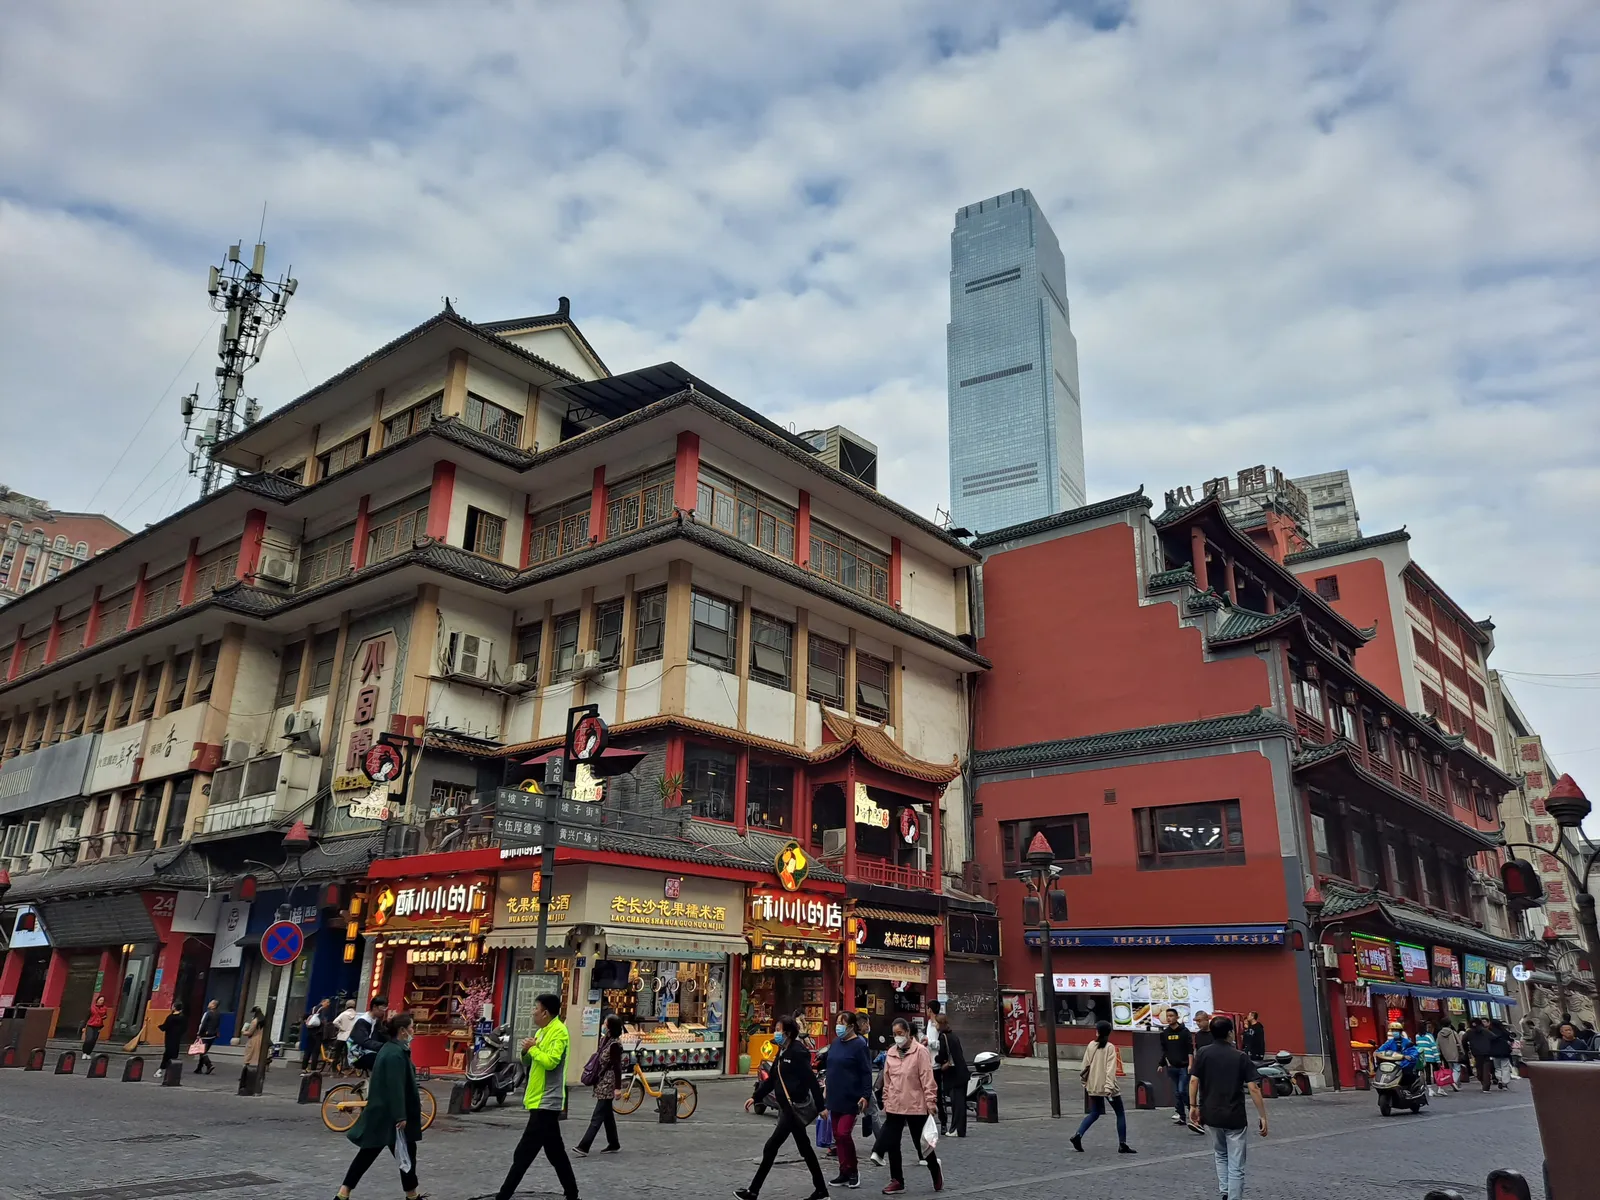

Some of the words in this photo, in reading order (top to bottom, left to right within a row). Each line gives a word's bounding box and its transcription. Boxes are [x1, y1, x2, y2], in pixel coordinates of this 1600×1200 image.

[345, 640, 386, 771] 火宫殿
[552, 757, 563, 783] 天心区
[507, 793, 544, 809] 坡子街
[561, 802, 594, 818] 坡子街
[504, 820, 542, 836] 伍厚德堂
[559, 828, 592, 844] 黄兴广场
[1520, 743, 1573, 931] 湖南省财政医院
[153, 896, 174, 911] 24
[611, 895, 726, 921] 老长沙花果糯米酒
[611, 914, 625, 923] LAO
[626, 915, 650, 924] CHANG
[651, 918, 664, 926] SHA
[664, 919, 678, 927] HUA
[679, 920, 693, 929] GUO
[693, 921, 707, 930] NUO
[1056, 977, 1102, 988] 宫殿外卖
